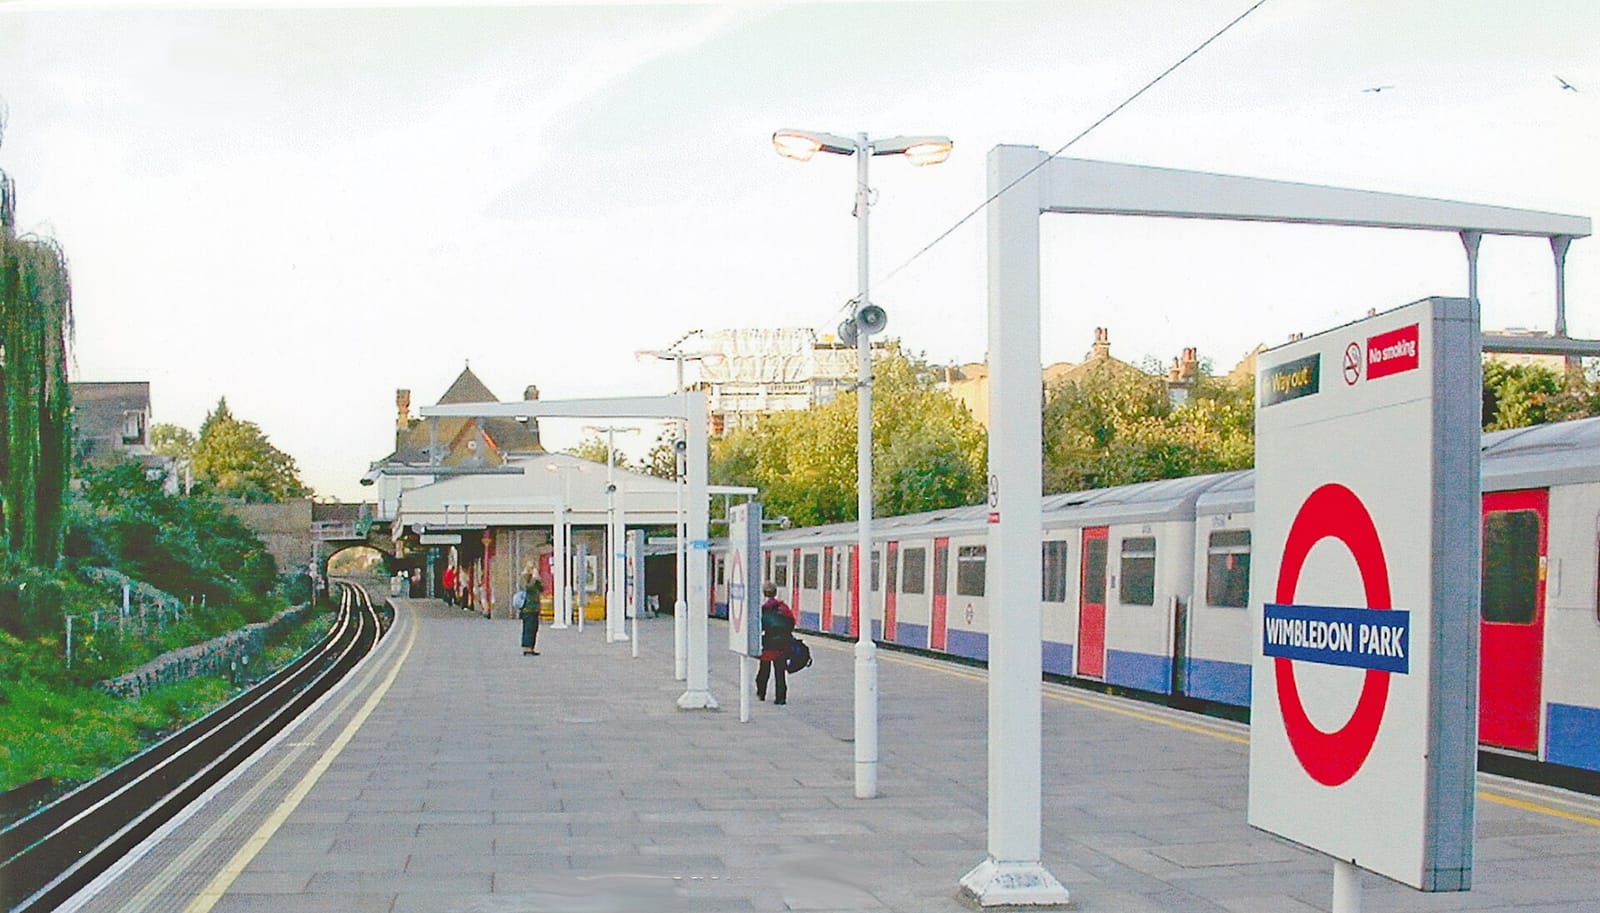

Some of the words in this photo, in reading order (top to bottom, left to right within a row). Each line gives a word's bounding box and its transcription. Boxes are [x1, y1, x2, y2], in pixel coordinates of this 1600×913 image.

[1369, 348, 1382, 364] No
[1383, 339, 1416, 360] smoking
[1271, 372, 1291, 394] Way
[1291, 367, 1310, 387] out
[1266, 617, 1353, 652] WIMBLEDON
[1359, 624, 1405, 658] PARK
